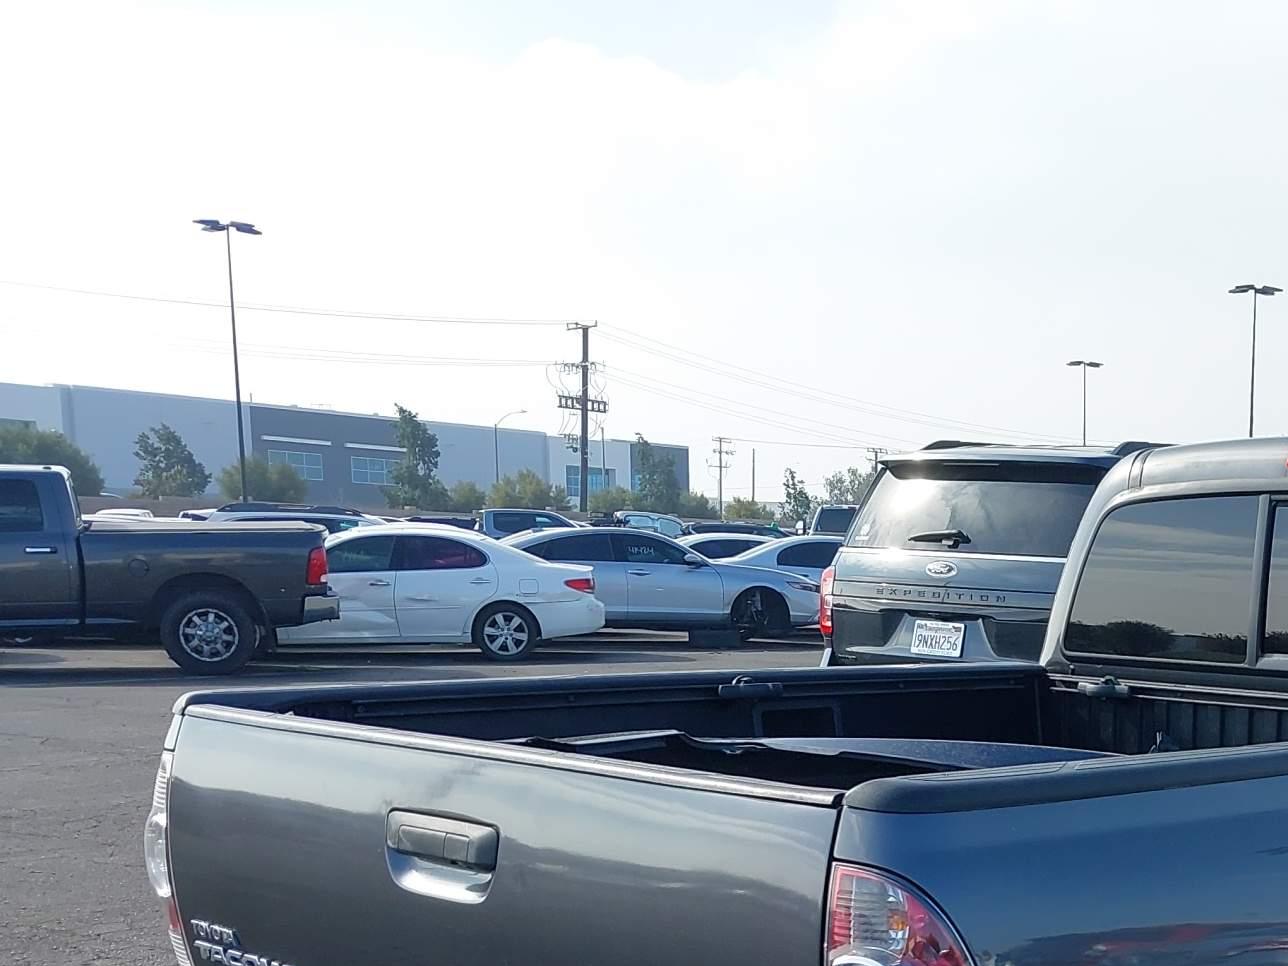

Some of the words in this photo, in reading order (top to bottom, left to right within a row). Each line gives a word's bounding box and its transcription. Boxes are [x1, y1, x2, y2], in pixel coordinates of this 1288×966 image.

[875, 587, 1006, 603] EXPEDITION
[915, 633, 960, 652] 9NXH256
[190, 919, 238, 945] TOYOTA
